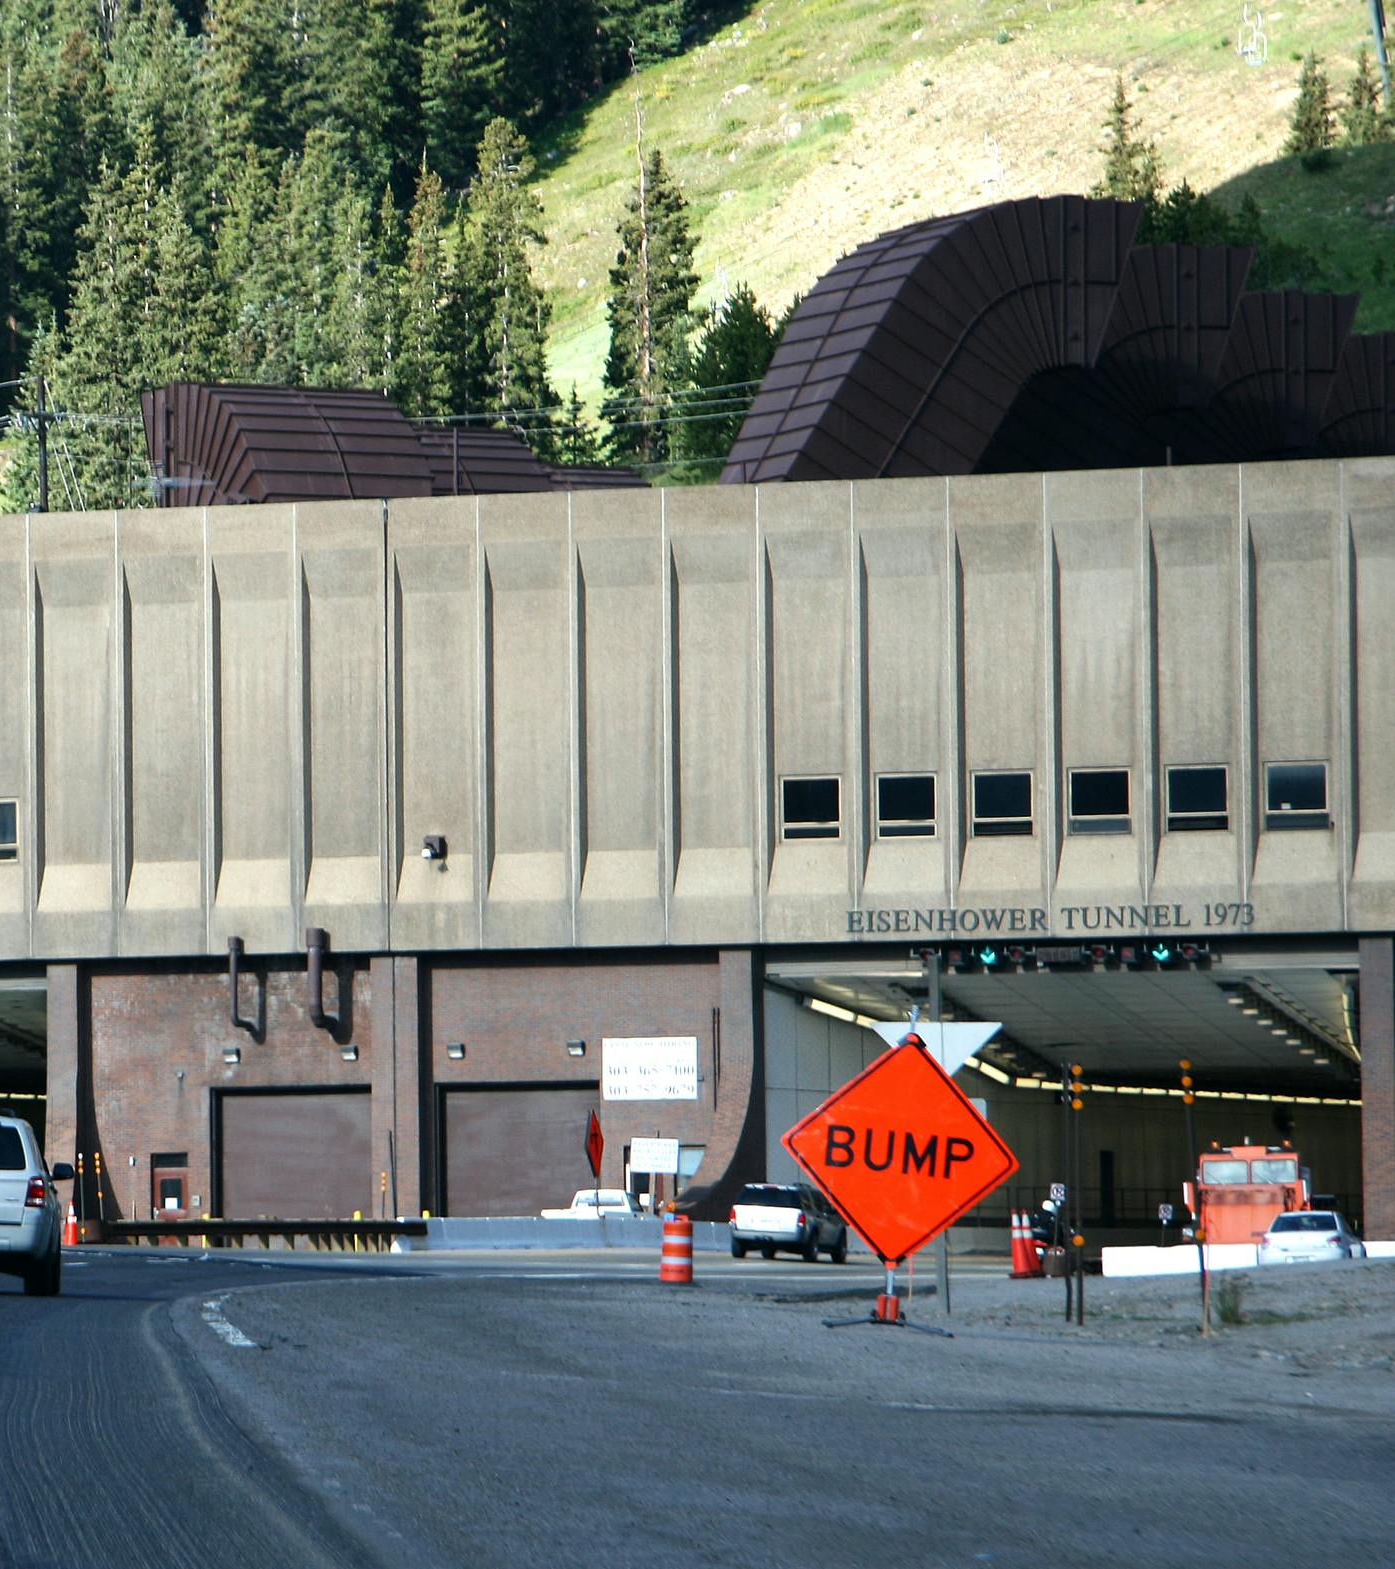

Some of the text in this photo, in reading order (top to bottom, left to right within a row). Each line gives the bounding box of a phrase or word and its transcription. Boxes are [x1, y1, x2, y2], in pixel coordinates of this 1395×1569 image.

[845, 903, 1255, 933] EISENHOWER TUNNEL 1973
[825, 1124, 975, 1179] BUMP
